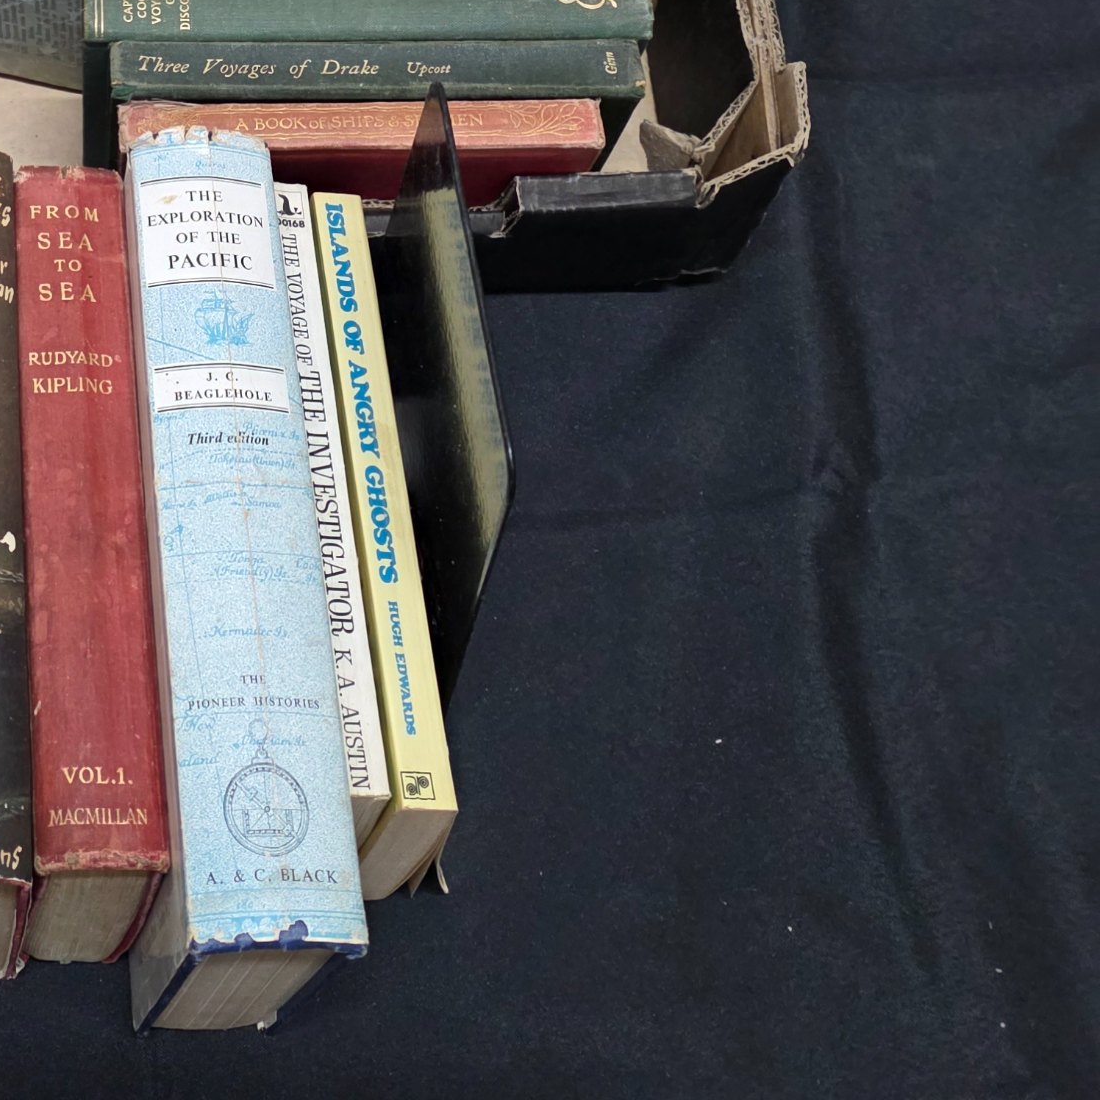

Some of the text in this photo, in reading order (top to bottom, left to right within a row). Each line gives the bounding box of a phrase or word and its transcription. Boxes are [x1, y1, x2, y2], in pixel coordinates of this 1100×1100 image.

[138, 54, 451, 79] Three Voyages of Drake Upcott
[605, 51, 618, 75] Ginn
[235, 117, 250, 132] A
[254, 116, 305, 131] BOOK
[308, 117, 327, 131] of
[331, 115, 385, 129] SHIPS
[186, 190, 223, 202] THE
[30, 205, 99, 223] FROM
[147, 210, 265, 228] EXPLORATION
[37, 232, 94, 251] SEA
[176, 231, 242, 245] OF THE
[54, 259, 82, 272] TO
[168, 252, 253, 271] PACIFIC
[38, 282, 97, 303] SEA
[28, 351, 113, 367] RUDYARD
[32, 377, 113, 395] KIPLING
[175, 389, 273, 402] BEAGLEHOLE
[188, 432, 269, 446] Third edition
[325, 203, 416, 735] ISLANDS OF ANGRY GHOSTS HUGH EDWARDS
[281, 234, 371, 790] THE VOYAGE OF THE INVESTIGATOR K. A. AUSTIN
[188, 696, 320, 710] PIONEER HISTORIES
[48, 807, 148, 827] MACMILLAN
